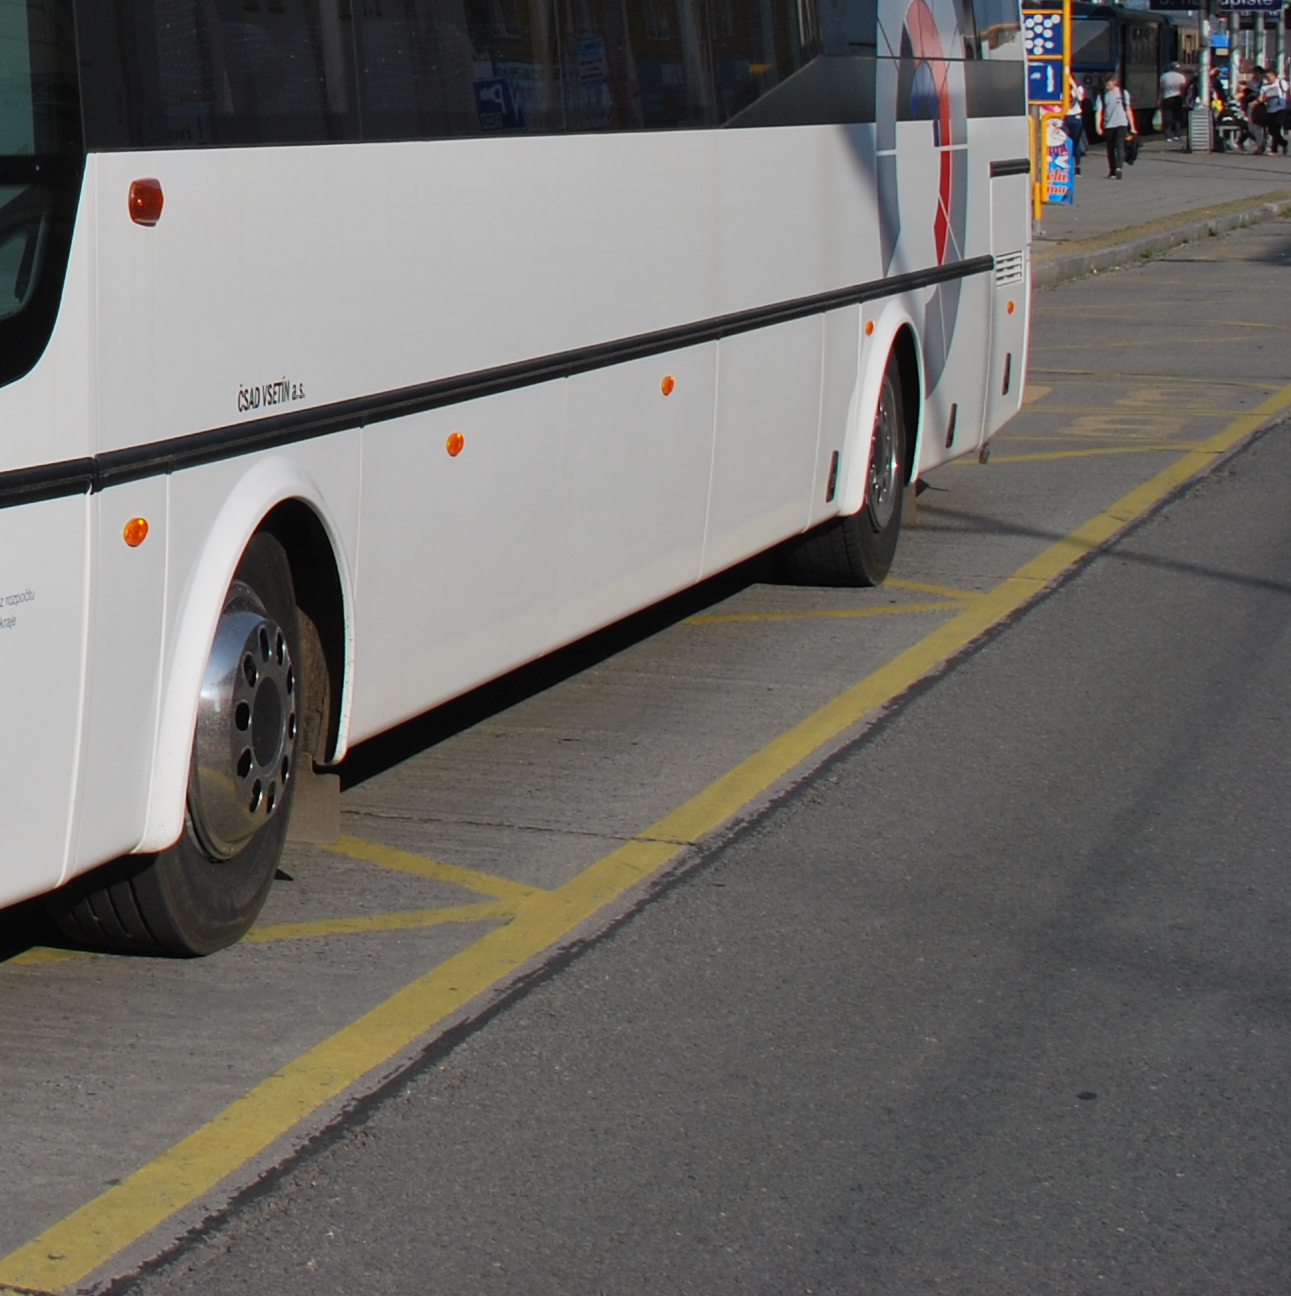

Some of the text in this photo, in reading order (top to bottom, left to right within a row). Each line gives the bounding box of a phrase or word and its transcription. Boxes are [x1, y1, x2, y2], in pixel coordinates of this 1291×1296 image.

[238, 376, 305, 412] ČSAD VSETÍN a.s.
[0, 597, 5, 608] z
[0, 614, 17, 630] kraje
